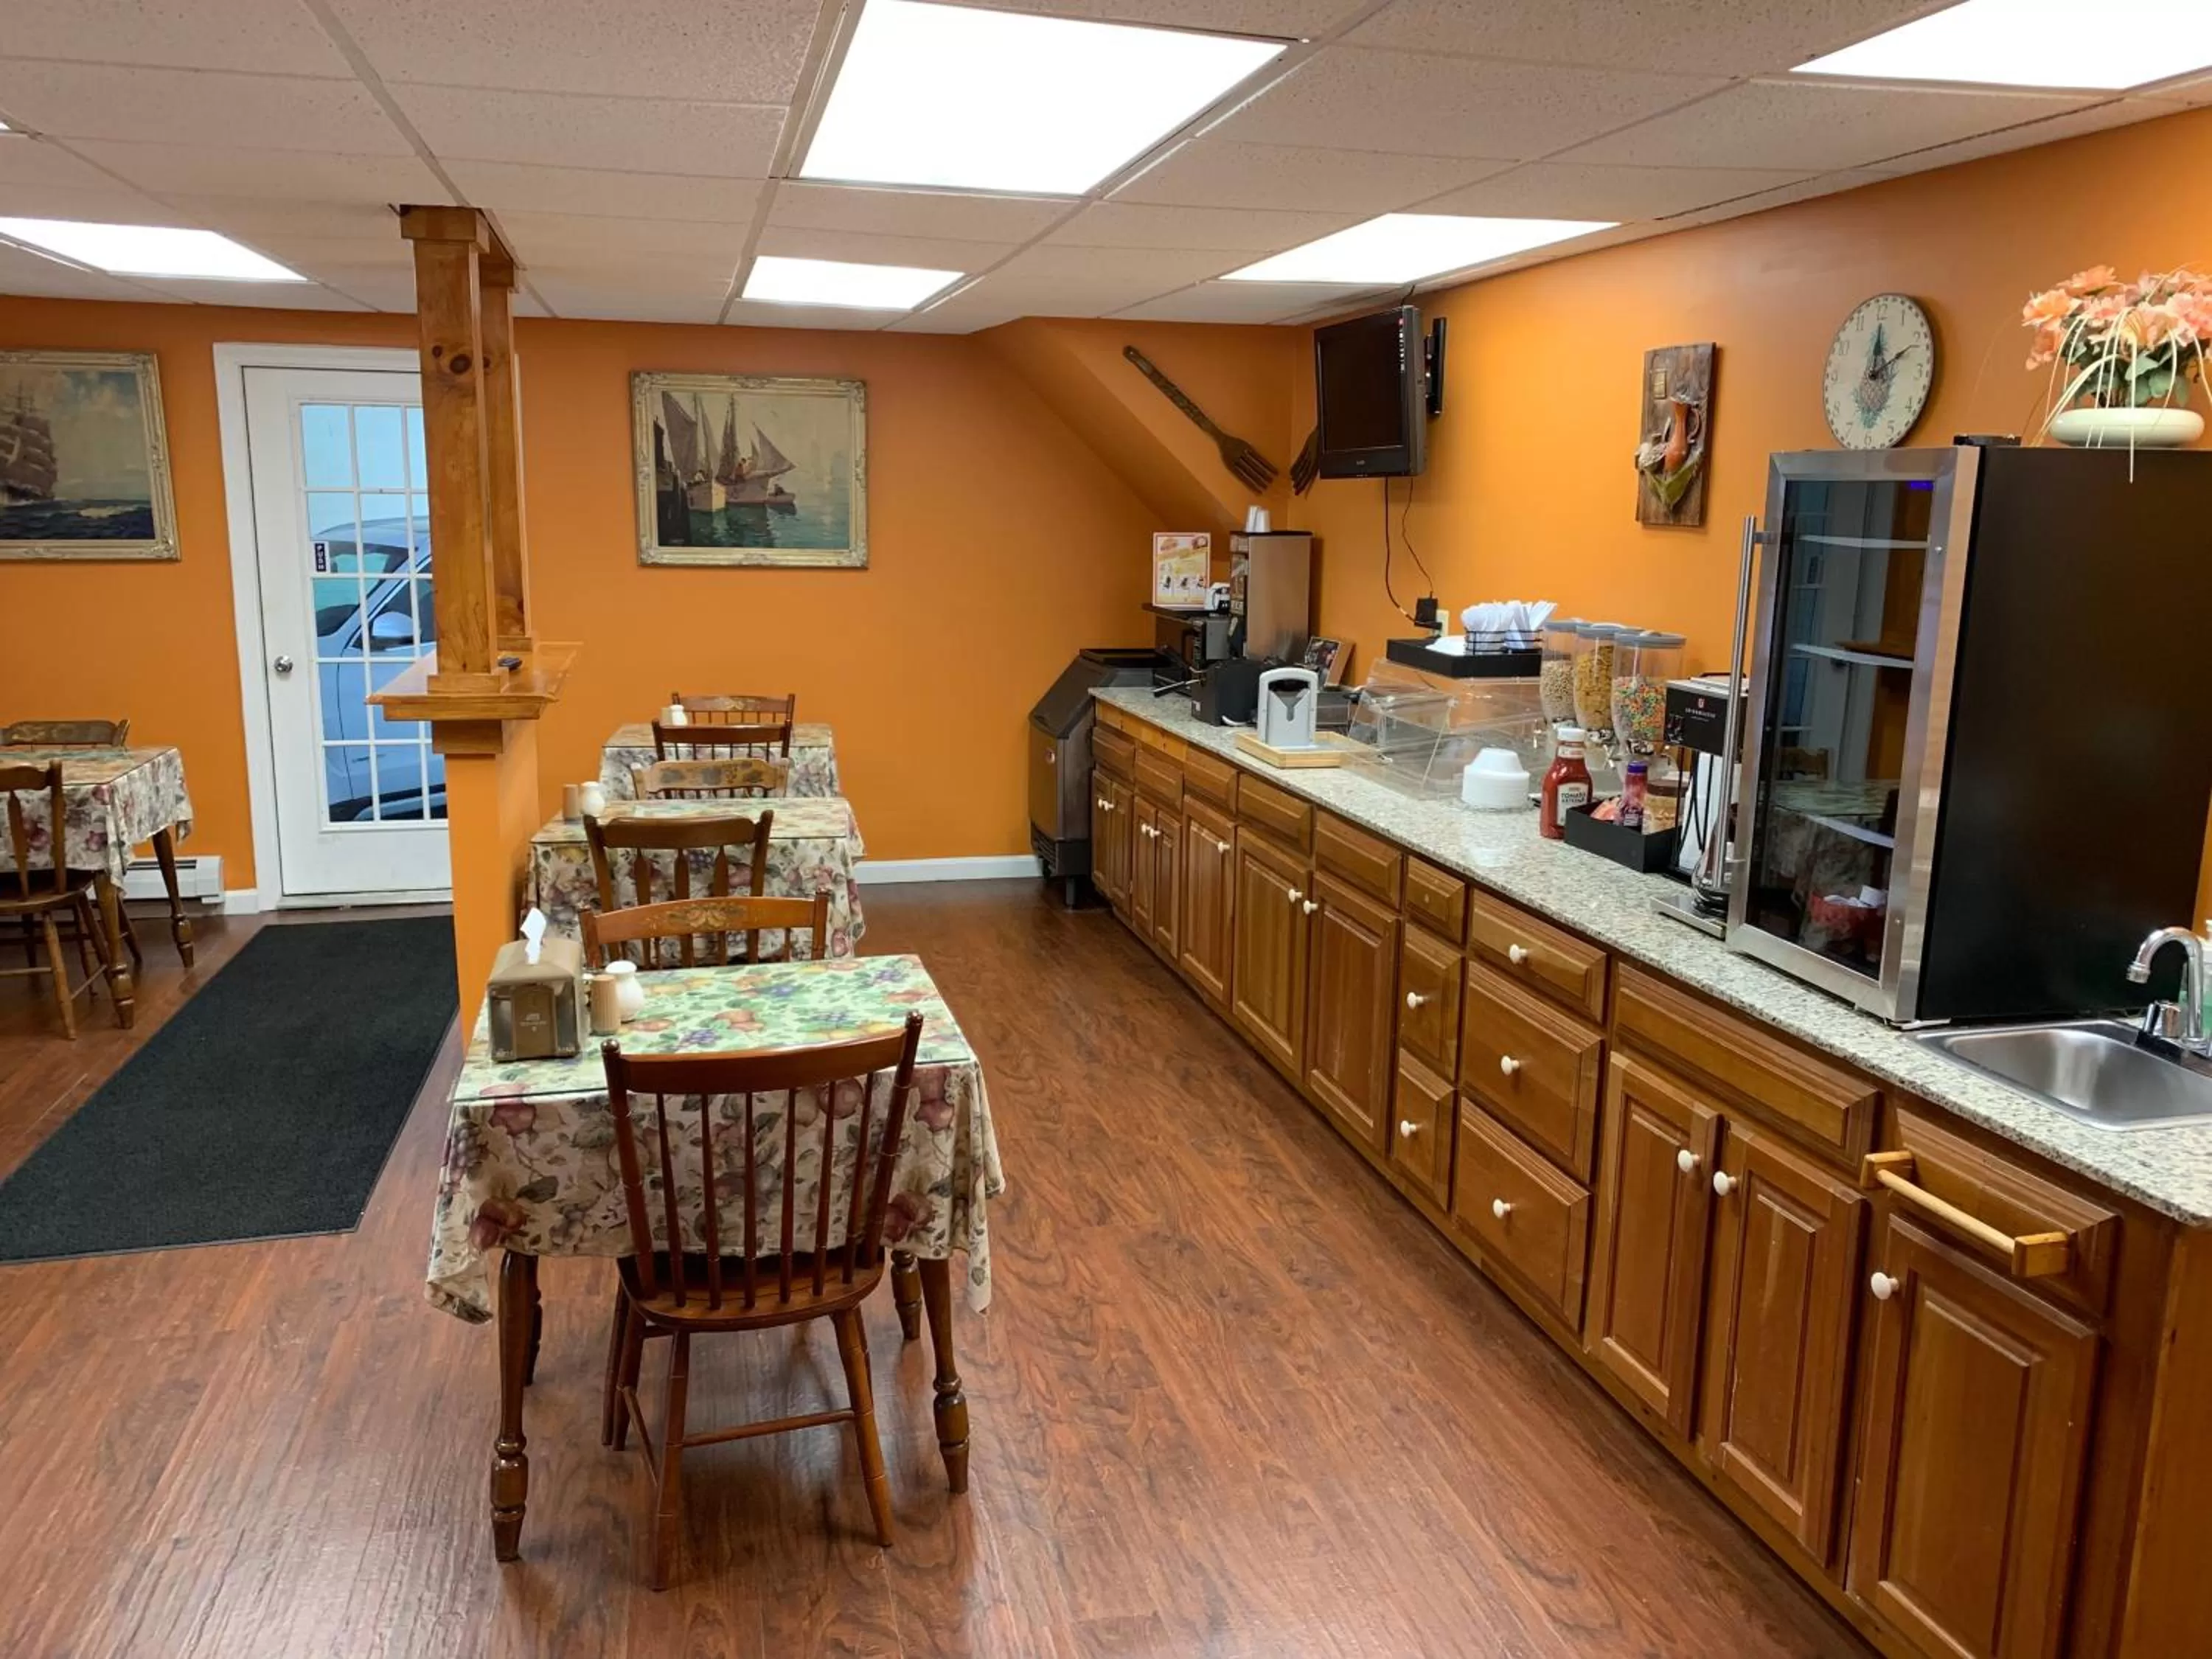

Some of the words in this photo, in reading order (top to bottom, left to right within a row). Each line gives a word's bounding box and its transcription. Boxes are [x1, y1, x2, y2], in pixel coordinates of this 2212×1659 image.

[1877, 304, 1888, 321] 12
[1856, 313, 1864, 331] 11
[1913, 331, 1921, 348] 2
[1838, 341, 1850, 356] 10
[1831, 370, 1838, 385] 9
[1913, 364, 1923, 380] 3
[1833, 400, 1840, 416] 8
[1905, 396, 1913, 413] 4
[1846, 422, 1853, 437] 7
[1887, 420, 1895, 436] 5
[1864, 430, 1871, 446] 6
